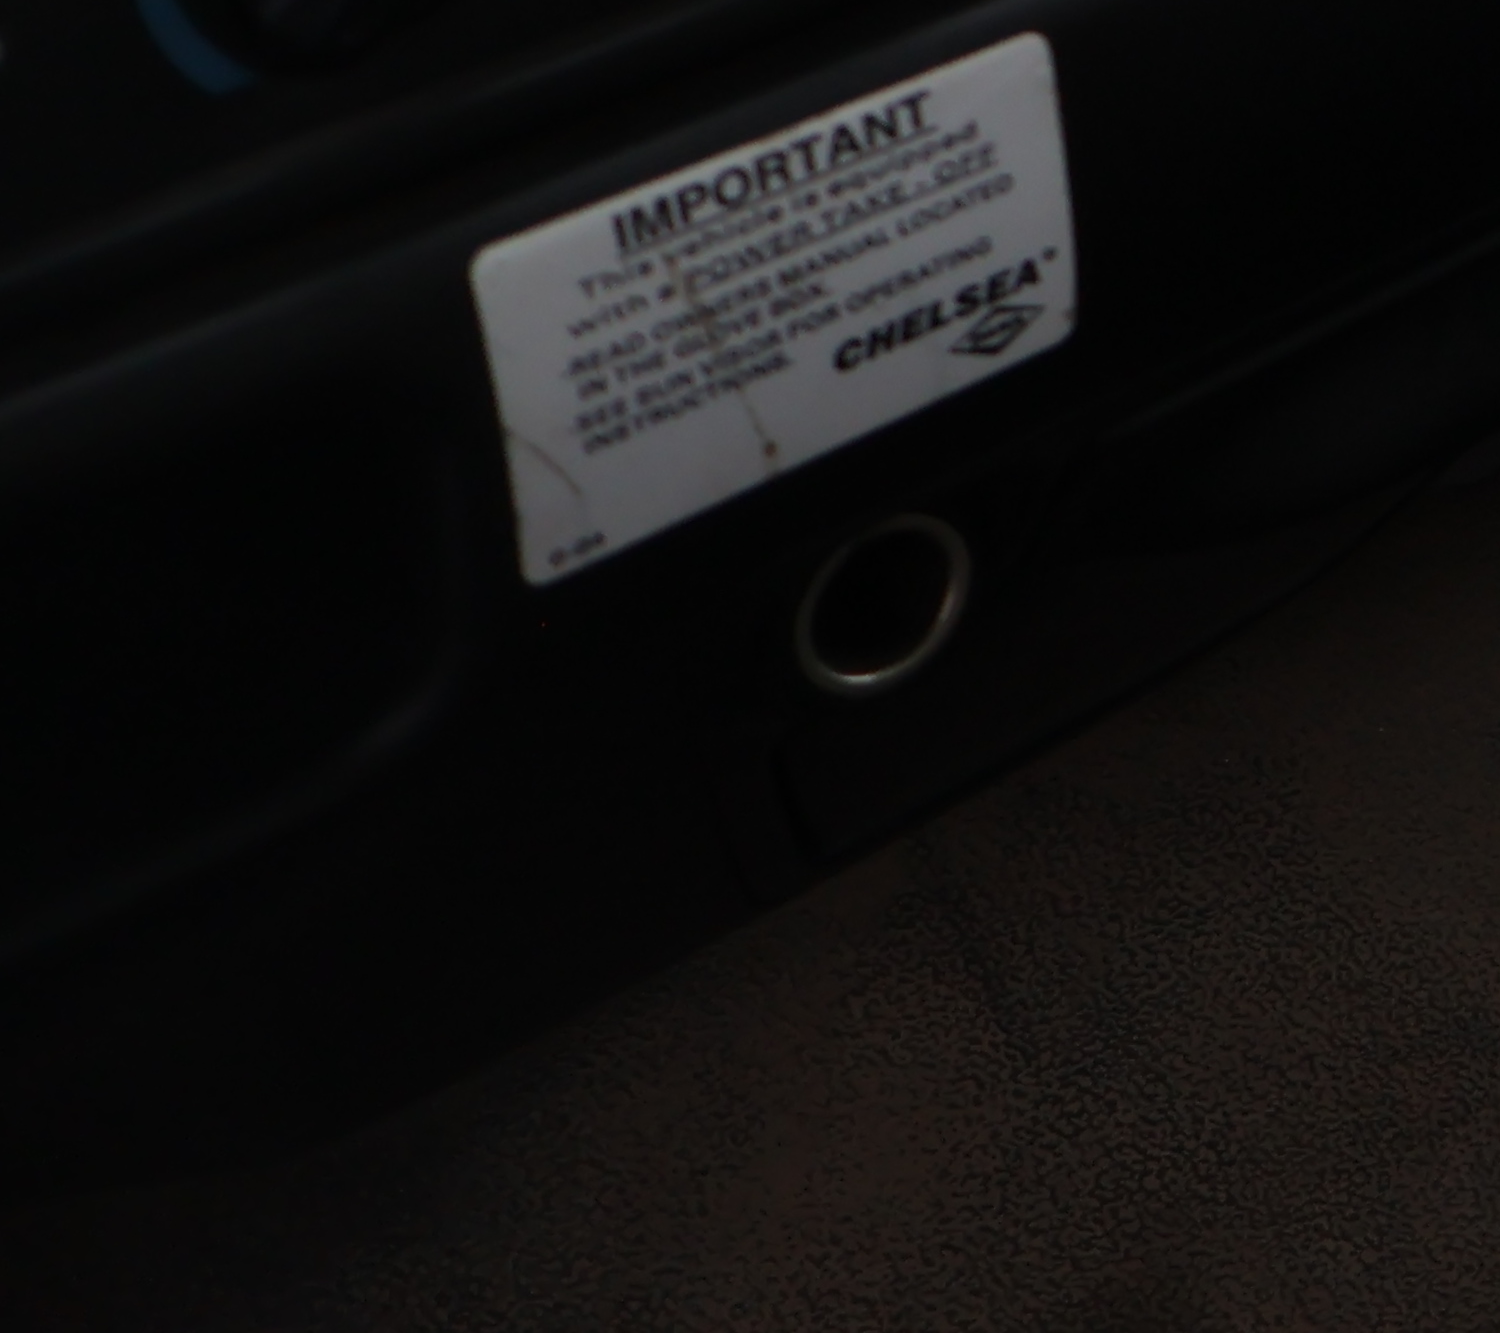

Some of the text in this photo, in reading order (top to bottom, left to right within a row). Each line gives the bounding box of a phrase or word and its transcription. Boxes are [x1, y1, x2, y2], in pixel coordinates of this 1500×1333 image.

[566, 291, 649, 342] with
[688, 212, 828, 291] POWER
[832, 177, 909, 230] TAKE
[930, 140, 997, 189] OFF
[578, 118, 981, 303] This vehicle is equipped
[609, 88, 934, 254] IMPORTANT
[566, 170, 1015, 380] READ OWNERS MANUAL LOCATED
[574, 232, 992, 433] SEE SUN VISOR FOR OPERATING
[577, 373, 608, 402] IN
[615, 348, 666, 386] THE
[673, 306, 763, 361] GLOVE
